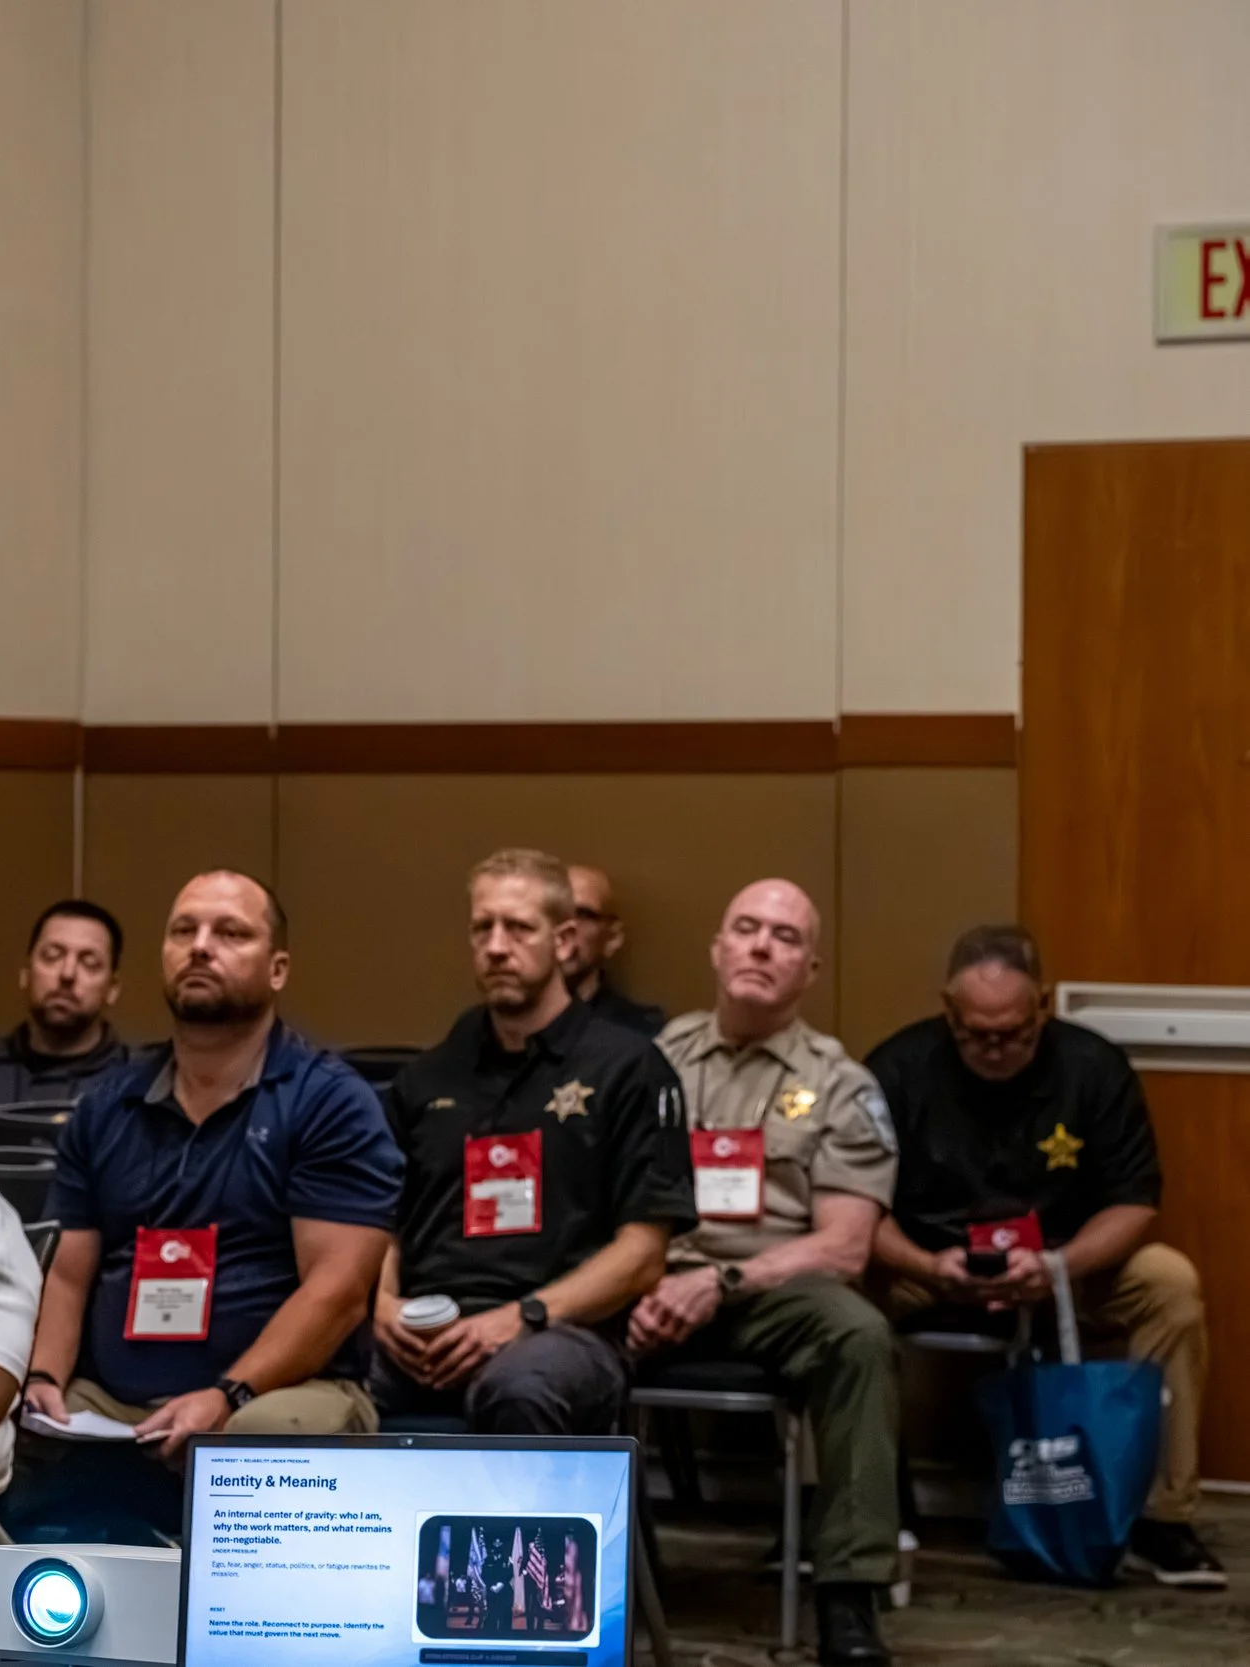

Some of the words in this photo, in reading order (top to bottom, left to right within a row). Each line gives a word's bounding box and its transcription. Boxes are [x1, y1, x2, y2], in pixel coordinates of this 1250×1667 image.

[210, 1474, 262, 1490] Identity
[265, 1475, 275, 1487] &
[279, 1475, 338, 1491] Meaning
[214, 1509, 226, 1518] An
[228, 1509, 262, 1519] internal
[264, 1511, 292, 1519] center
[294, 1511, 304, 1519] of
[305, 1511, 338, 1521] gravity:
[339, 1511, 359, 1520] who
[365, 1513, 382, 1521] am,
[213, 1522, 232, 1532] why
[234, 1522, 248, 1531] the
[250, 1523, 272, 1531] work
[274, 1523, 311, 1533] matters,
[313, 1524, 330, 1532] and
[332, 1524, 354, 1532] what
[356, 1525, 392, 1533] remains
[213, 1535, 282, 1546] non-negotiable.
[326, 1563, 349, 1571] fatigue
[262, 1620, 301, 1628] Reconnect
[344, 1622, 371, 1630] Identify
